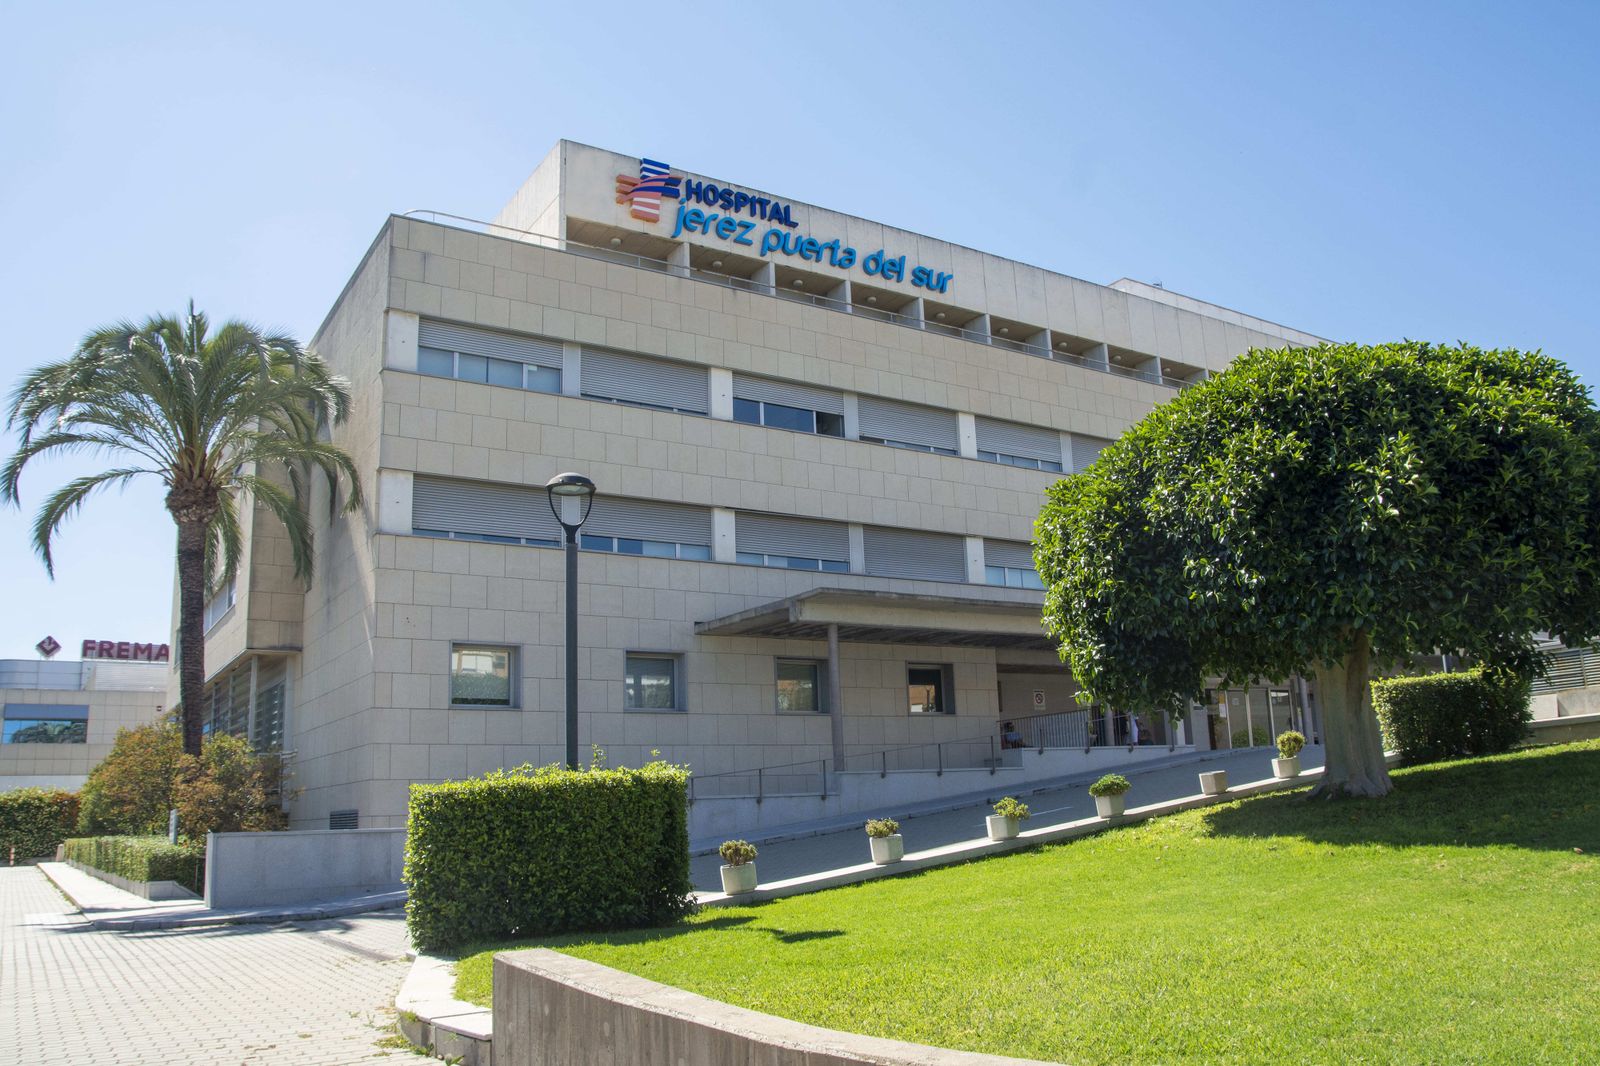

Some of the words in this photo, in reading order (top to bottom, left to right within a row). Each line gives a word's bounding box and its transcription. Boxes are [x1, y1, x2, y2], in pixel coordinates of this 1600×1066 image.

[685, 179, 798, 228] HOSPITAL
[671, 198, 756, 245] jerez
[760, 229, 856, 269] puerta
[863, 250, 906, 283] del
[911, 265, 953, 293] sur
[82, 639, 169, 662] FREMA
